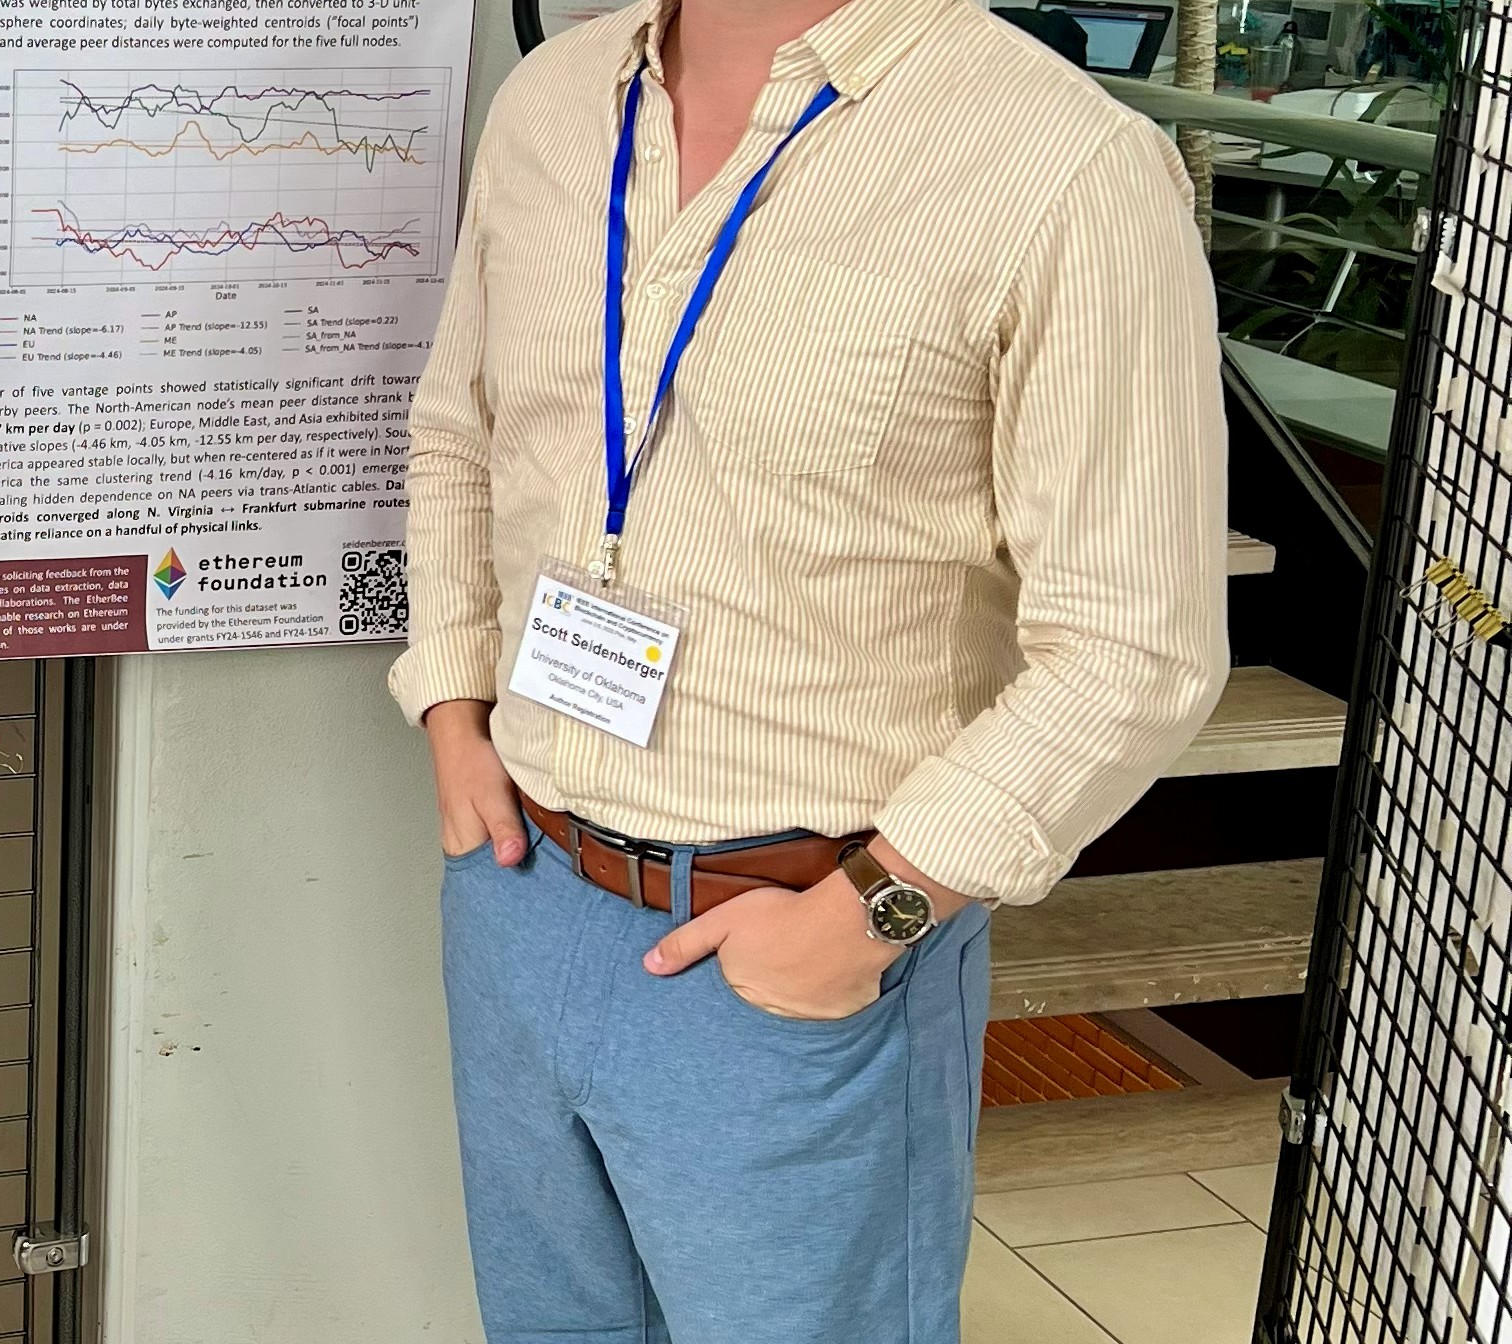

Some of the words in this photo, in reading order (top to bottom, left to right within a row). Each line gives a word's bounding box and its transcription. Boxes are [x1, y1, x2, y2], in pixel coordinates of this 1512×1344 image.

[216, 292, 237, 301] Date
[24, 314, 36, 322] NA
[166, 310, 177, 319] AP
[308, 306, 319, 314] SA
[23, 340, 35, 349] EU
[164, 336, 177, 345] ME
[12, 385, 25, 398] of
[32, 385, 54, 397] five
[61, 385, 109, 398] vantage
[115, 383, 153, 397] points
[160, 380, 206, 393] showed
[213, 378, 279, 392] statistically
[285, 376, 344, 392] significant
[350, 373, 376, 387] drift
[35, 528, 83, 539] reliance
[86, 528, 102, 537] on
[104, 528, 112, 537] a
[115, 523, 162, 536] handful
[165, 522, 178, 534] of
[180, 520, 228, 536] physical
[231, 519, 262, 531] links.
[198, 552, 303, 571] ethereum
[197, 571, 327, 592] foundation
[155, 607, 173, 616] The
[174, 605, 209, 616] funding
[211, 604, 224, 614] for
[226, 604, 243, 613] this
[244, 603, 278, 612] dataset
[531, 617, 568, 642] Scott
[571, 633, 664, 681] Seidenberger
[531, 648, 581, 678] University
[581, 671, 594, 682] of
[594, 674, 646, 705] Oklahoma
[547, 672, 586, 695] Oklahoma
